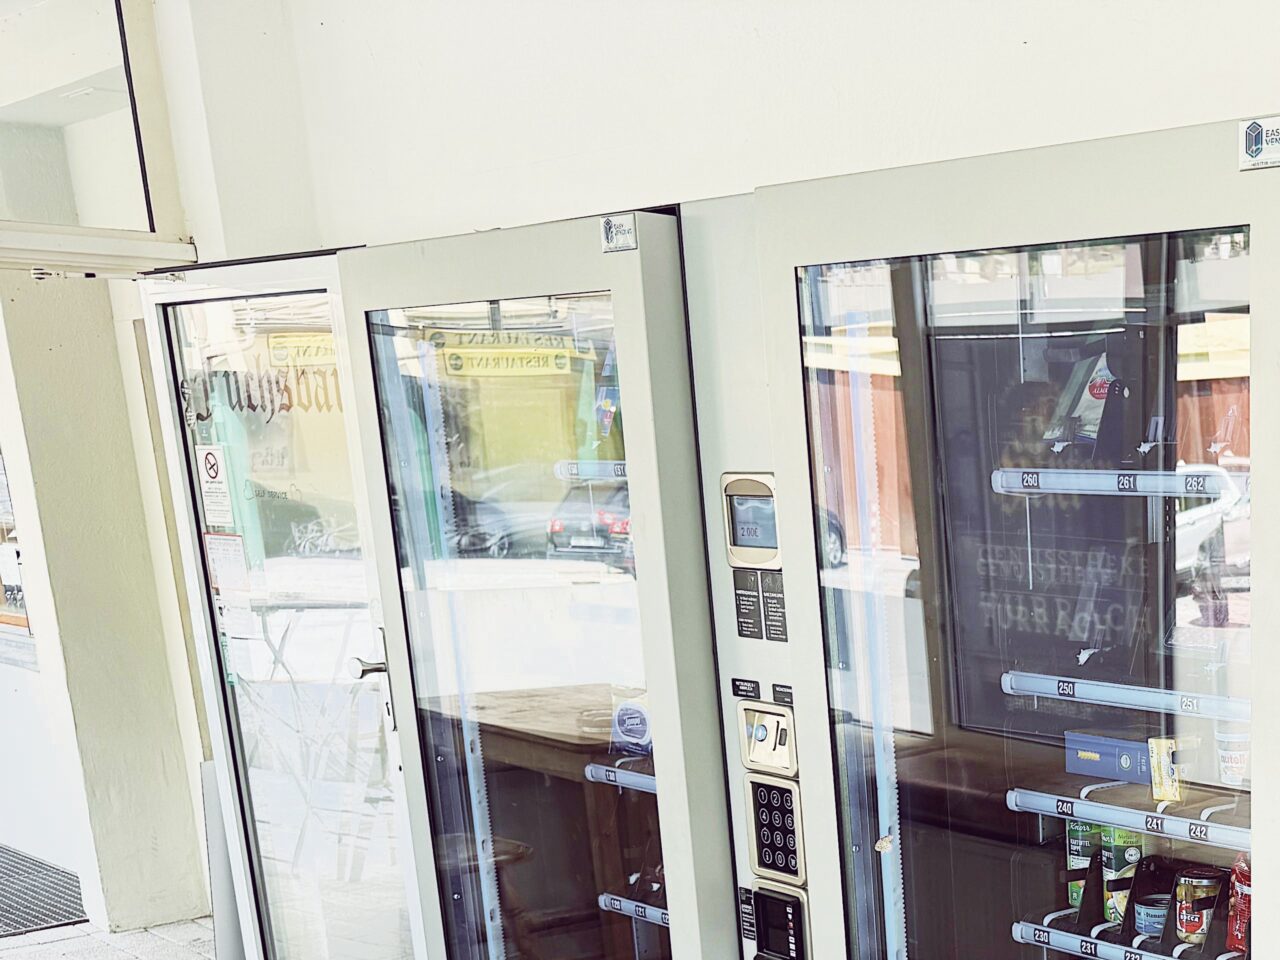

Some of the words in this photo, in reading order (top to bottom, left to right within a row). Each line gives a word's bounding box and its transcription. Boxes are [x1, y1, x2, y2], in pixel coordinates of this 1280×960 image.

[1022, 473, 1038, 487] 260
[1118, 476, 1134, 489] 261
[1186, 477, 1203, 490] 262
[1058, 682, 1073, 695] 250
[1182, 698, 1197, 711] 251
[1057, 802, 1072, 814] 240
[1070, 822, 1091, 832] Knorr
[1146, 817, 1162, 830] 241
[1190, 825, 1206, 838] 242
[635, 907, 646, 917] 121
[1034, 931, 1048, 943] 230
[1081, 942, 1096, 954] 231
